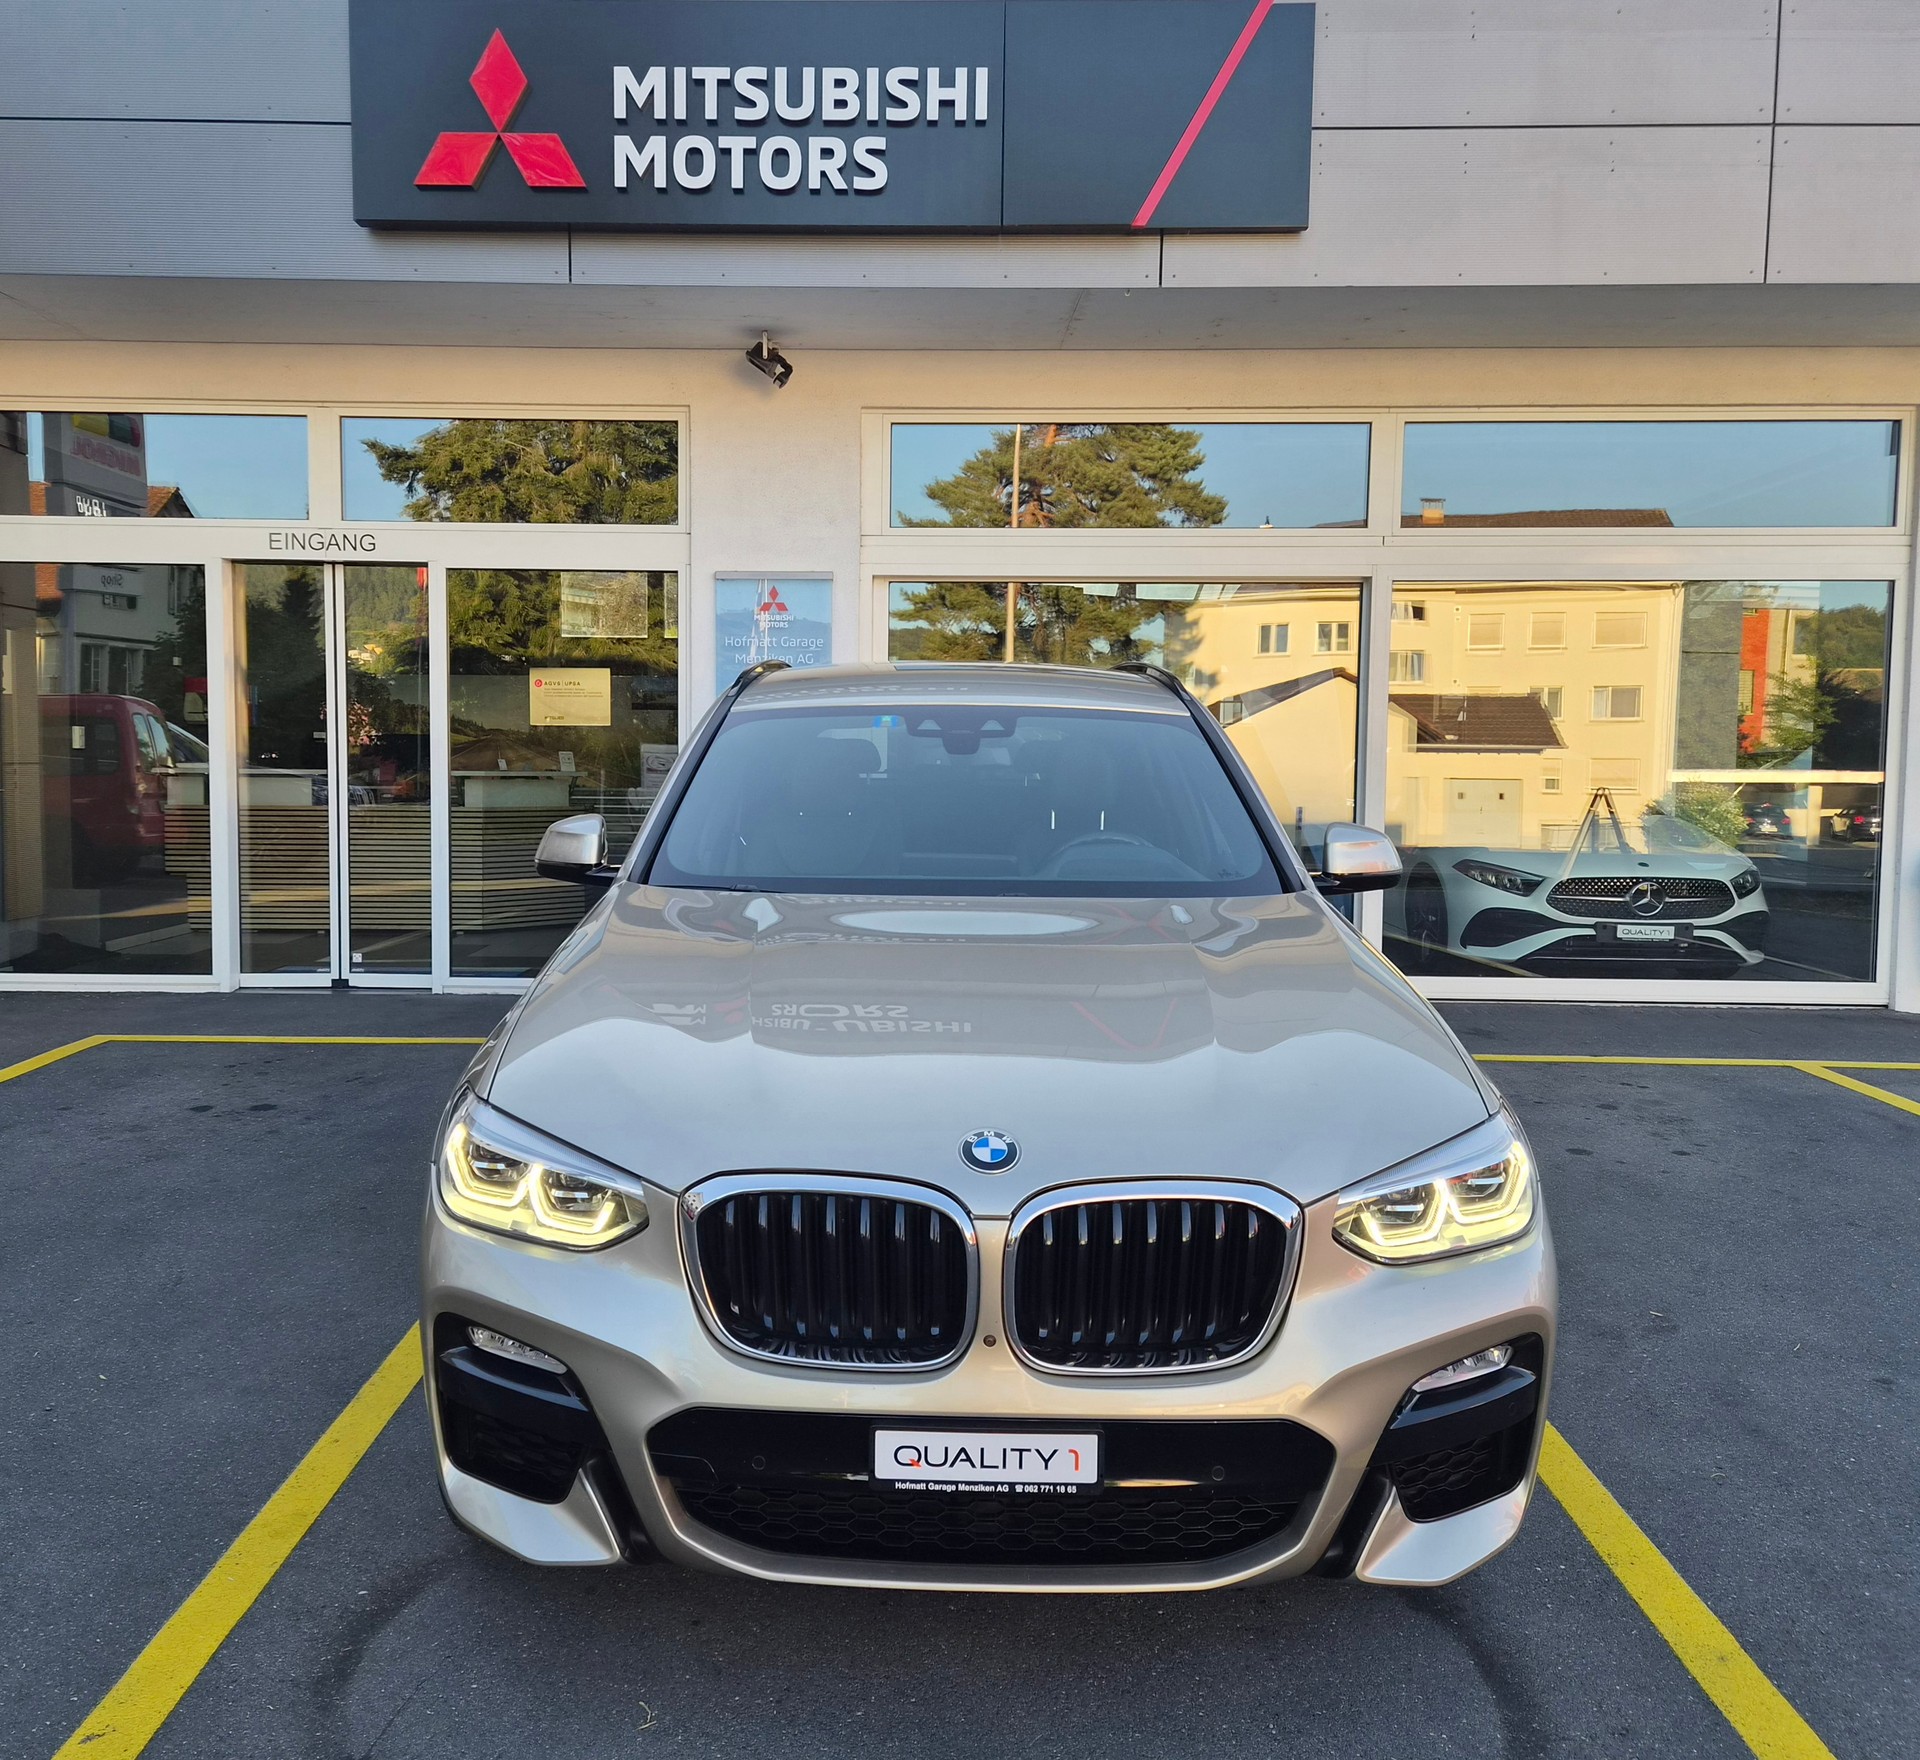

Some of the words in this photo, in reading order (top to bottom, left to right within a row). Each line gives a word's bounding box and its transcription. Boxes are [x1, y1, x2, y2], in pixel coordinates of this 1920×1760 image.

[613, 65, 988, 121] MITSUBISHI
[613, 135, 888, 191] MOTORS
[269, 532, 376, 552] EINGANG
[725, 636, 777, 647] Hofmatt
[781, 636, 824, 650] Garage
[797, 654, 814, 664] AG
[967, 1131, 1013, 1143] BMW
[893, 1445, 1059, 1470] QUALITY
[1068, 1448, 1080, 1471] 1
[895, 1481, 926, 1491] Hofmatt
[928, 1483, 956, 1493] Garage
[958, 1483, 995, 1492] Menziken
[996, 1484, 1009, 1492] AG
[1024, 1485, 1039, 1493] 062
[1040, 1485, 1054, 1493] 771
